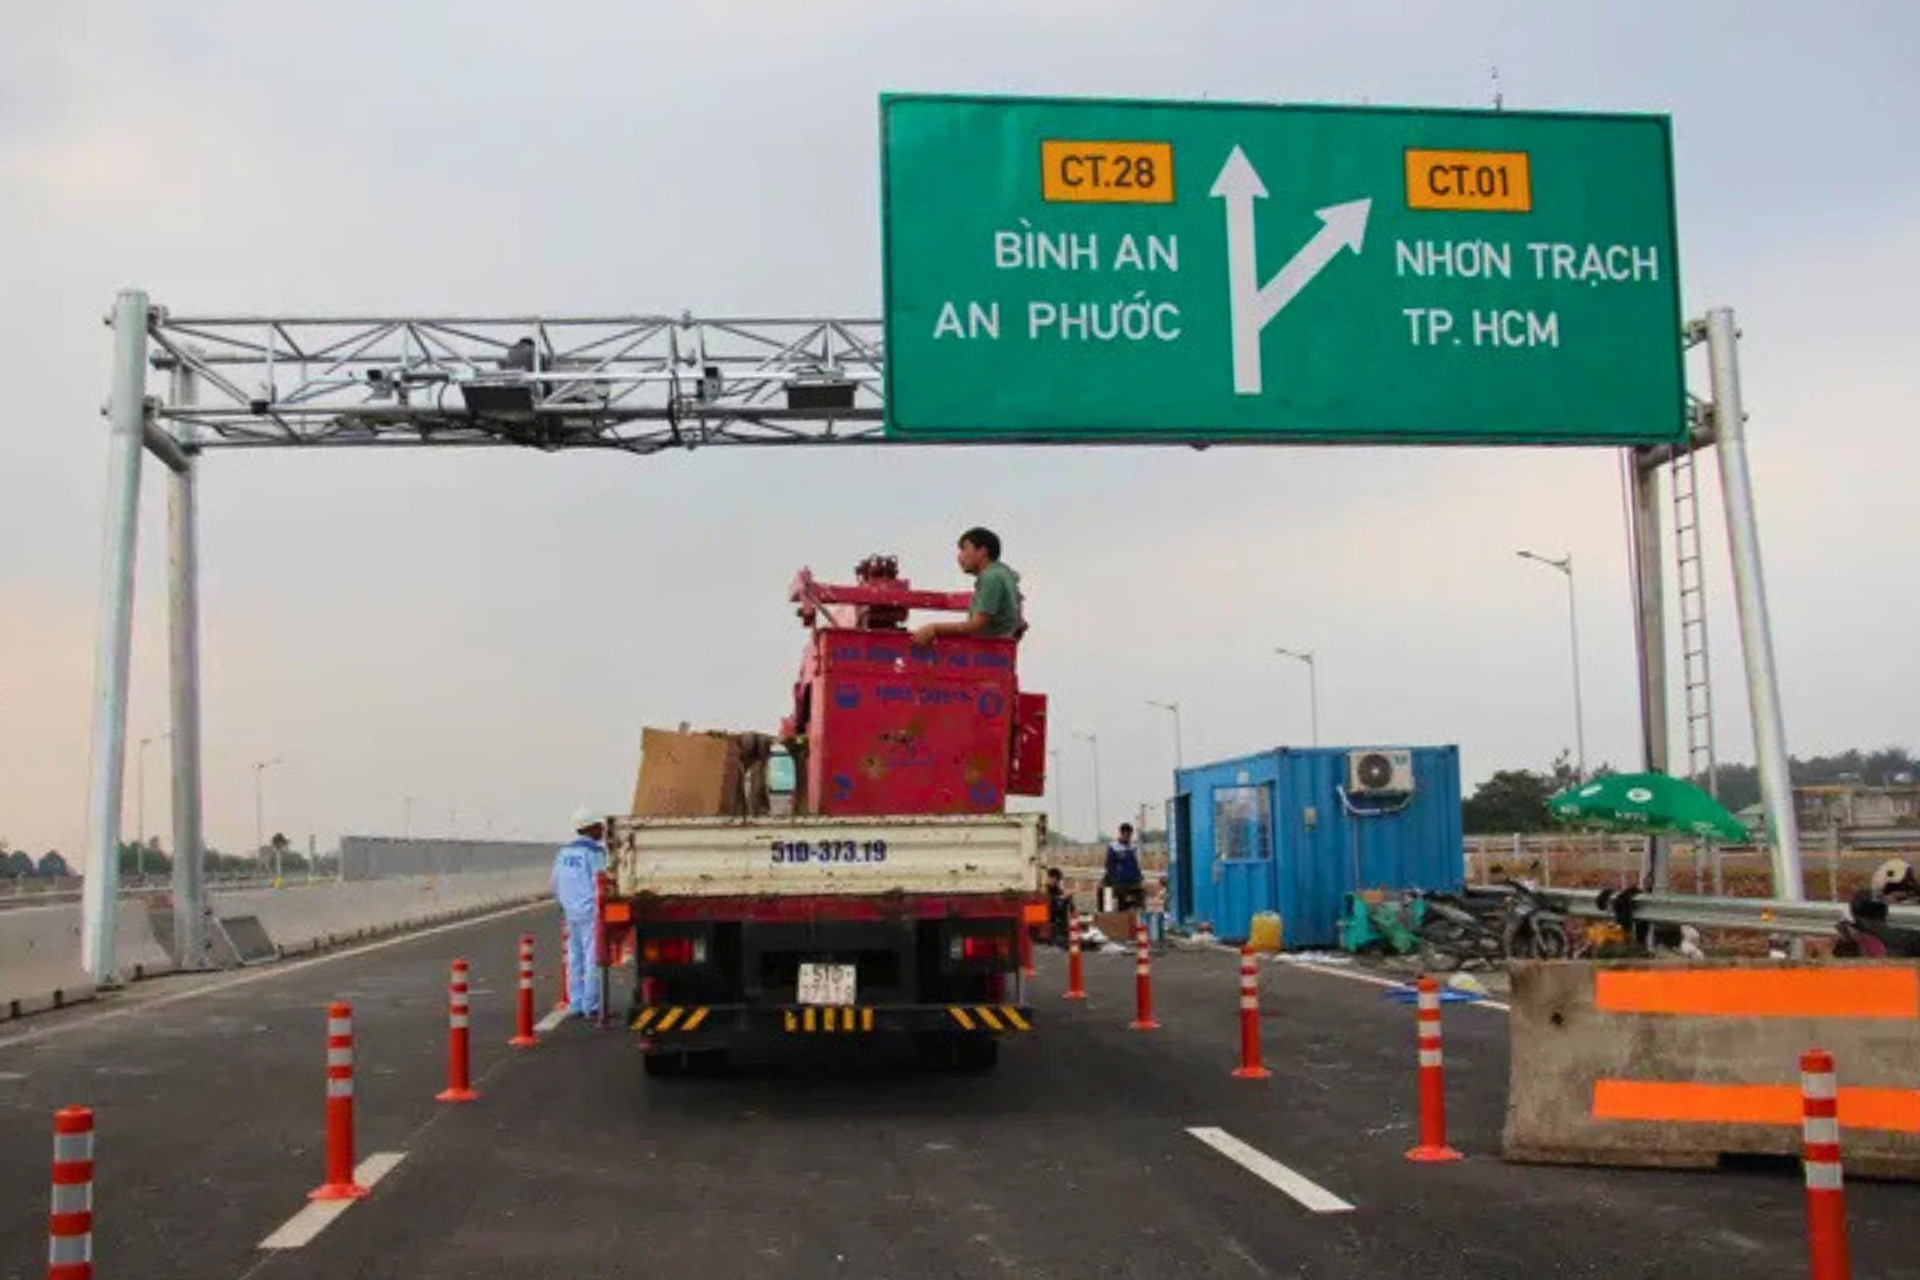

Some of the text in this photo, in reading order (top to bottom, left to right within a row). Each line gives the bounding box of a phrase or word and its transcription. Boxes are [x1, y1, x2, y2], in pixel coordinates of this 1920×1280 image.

[1061, 155, 1155, 188] CT.28
[1428, 164, 1508, 197] CT.01
[994, 218, 1179, 272] BÌNH AN
[1396, 238, 1659, 287] NHƠN TRẠCH
[933, 290, 1181, 341] AN PHƯỚC
[1472, 309, 1559, 348] HCM
